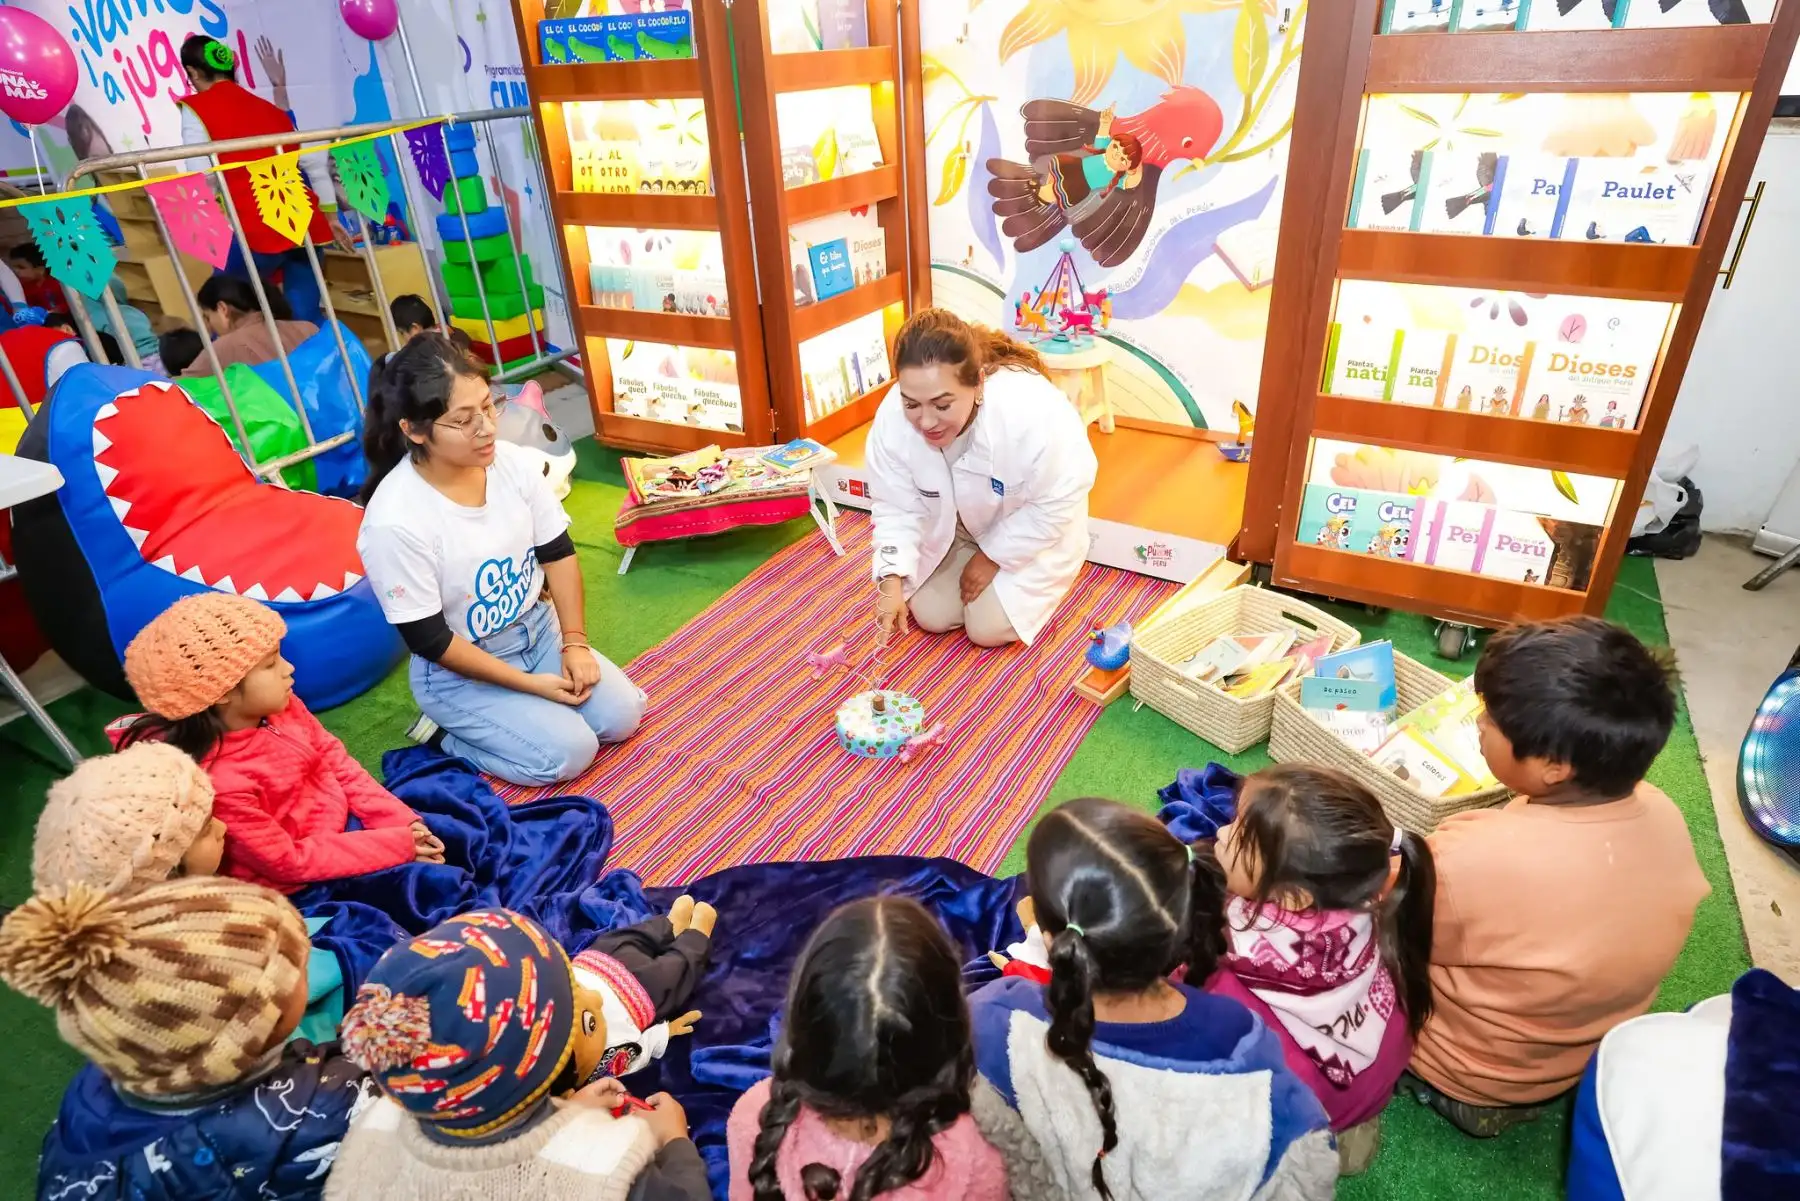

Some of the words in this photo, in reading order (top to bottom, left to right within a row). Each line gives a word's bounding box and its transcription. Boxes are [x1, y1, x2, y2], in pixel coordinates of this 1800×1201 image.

[607, 22, 616, 31] EL
[638, 18, 647, 27] EL
[647, 15, 686, 27] COCODRILO
[545, 25, 554, 34] EL
[568, 24, 577, 33] EL
[103, 71, 125, 104] a
[601, 167, 628, 177] OTRO
[1601, 181, 1677, 200] Paulet
[853, 238, 882, 253] Dioses
[1347, 359, 1374, 368] Plantas
[1547, 352, 1637, 379] Dioses
[1410, 367, 1438, 376] Plantas
[702, 397, 738, 409] quechuas
[1495, 533, 1546, 558] Perú
